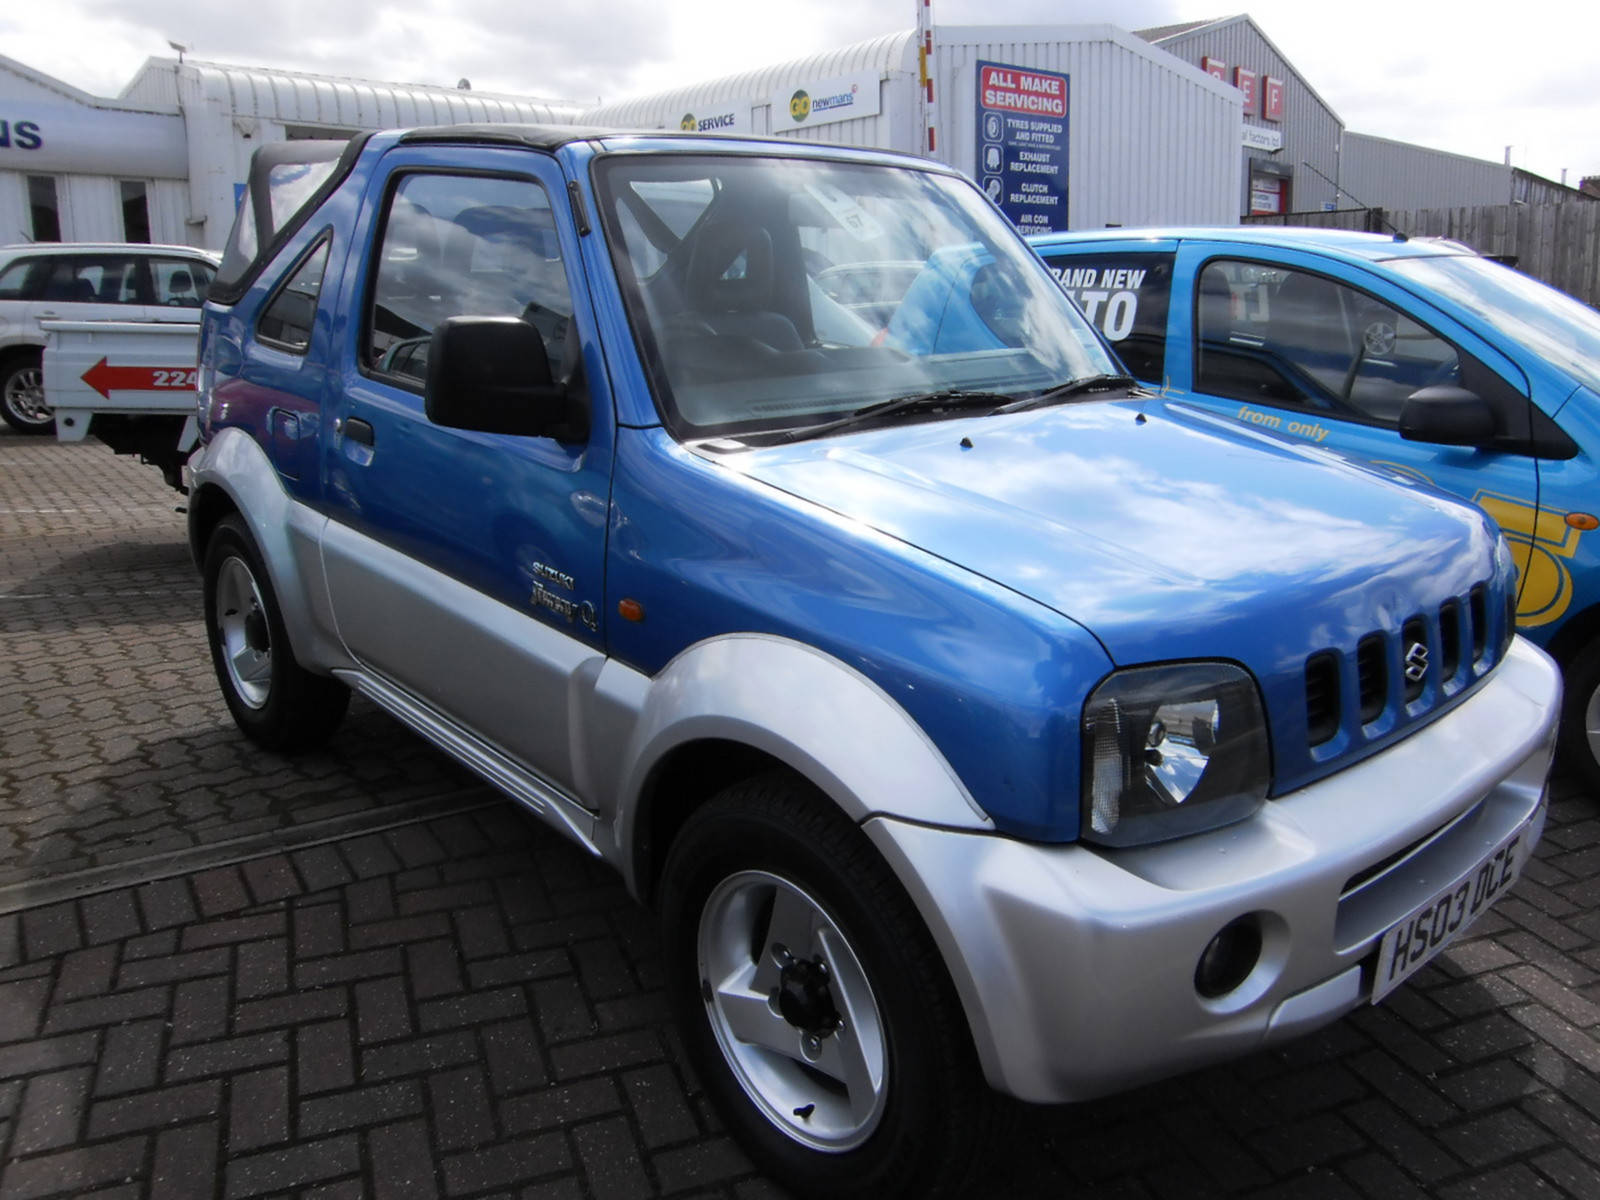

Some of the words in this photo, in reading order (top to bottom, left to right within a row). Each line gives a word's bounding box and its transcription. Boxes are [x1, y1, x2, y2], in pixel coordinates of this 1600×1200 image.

[988, 71, 1016, 89] ALL
[1020, 75, 1060, 95] MAKE
[812, 93, 854, 109] newmans
[985, 89, 1063, 114] SERVICING
[698, 113, 735, 132] SERVICE
[1007, 118, 1029, 130] TYRES
[1030, 121, 1063, 134] SUPPLIED
[1016, 131, 1030, 141] AND
[1031, 133, 1055, 144] FITTED
[1019, 151, 1051, 163] EXHAUST
[1009, 161, 1059, 175] REPLACEMENT
[1021, 182, 1049, 194] CLUTCH
[1009, 193, 1059, 206] REPLACEMENT
[1020, 214, 1032, 224] AIR
[1033, 215, 1049, 225] CON
[1100, 269, 1147, 289] NEW
[1066, 290, 1138, 342] TO
[1237, 406, 1282, 428] from
[1287, 421, 1330, 443] only
[1470, 835, 1521, 915] DCE
